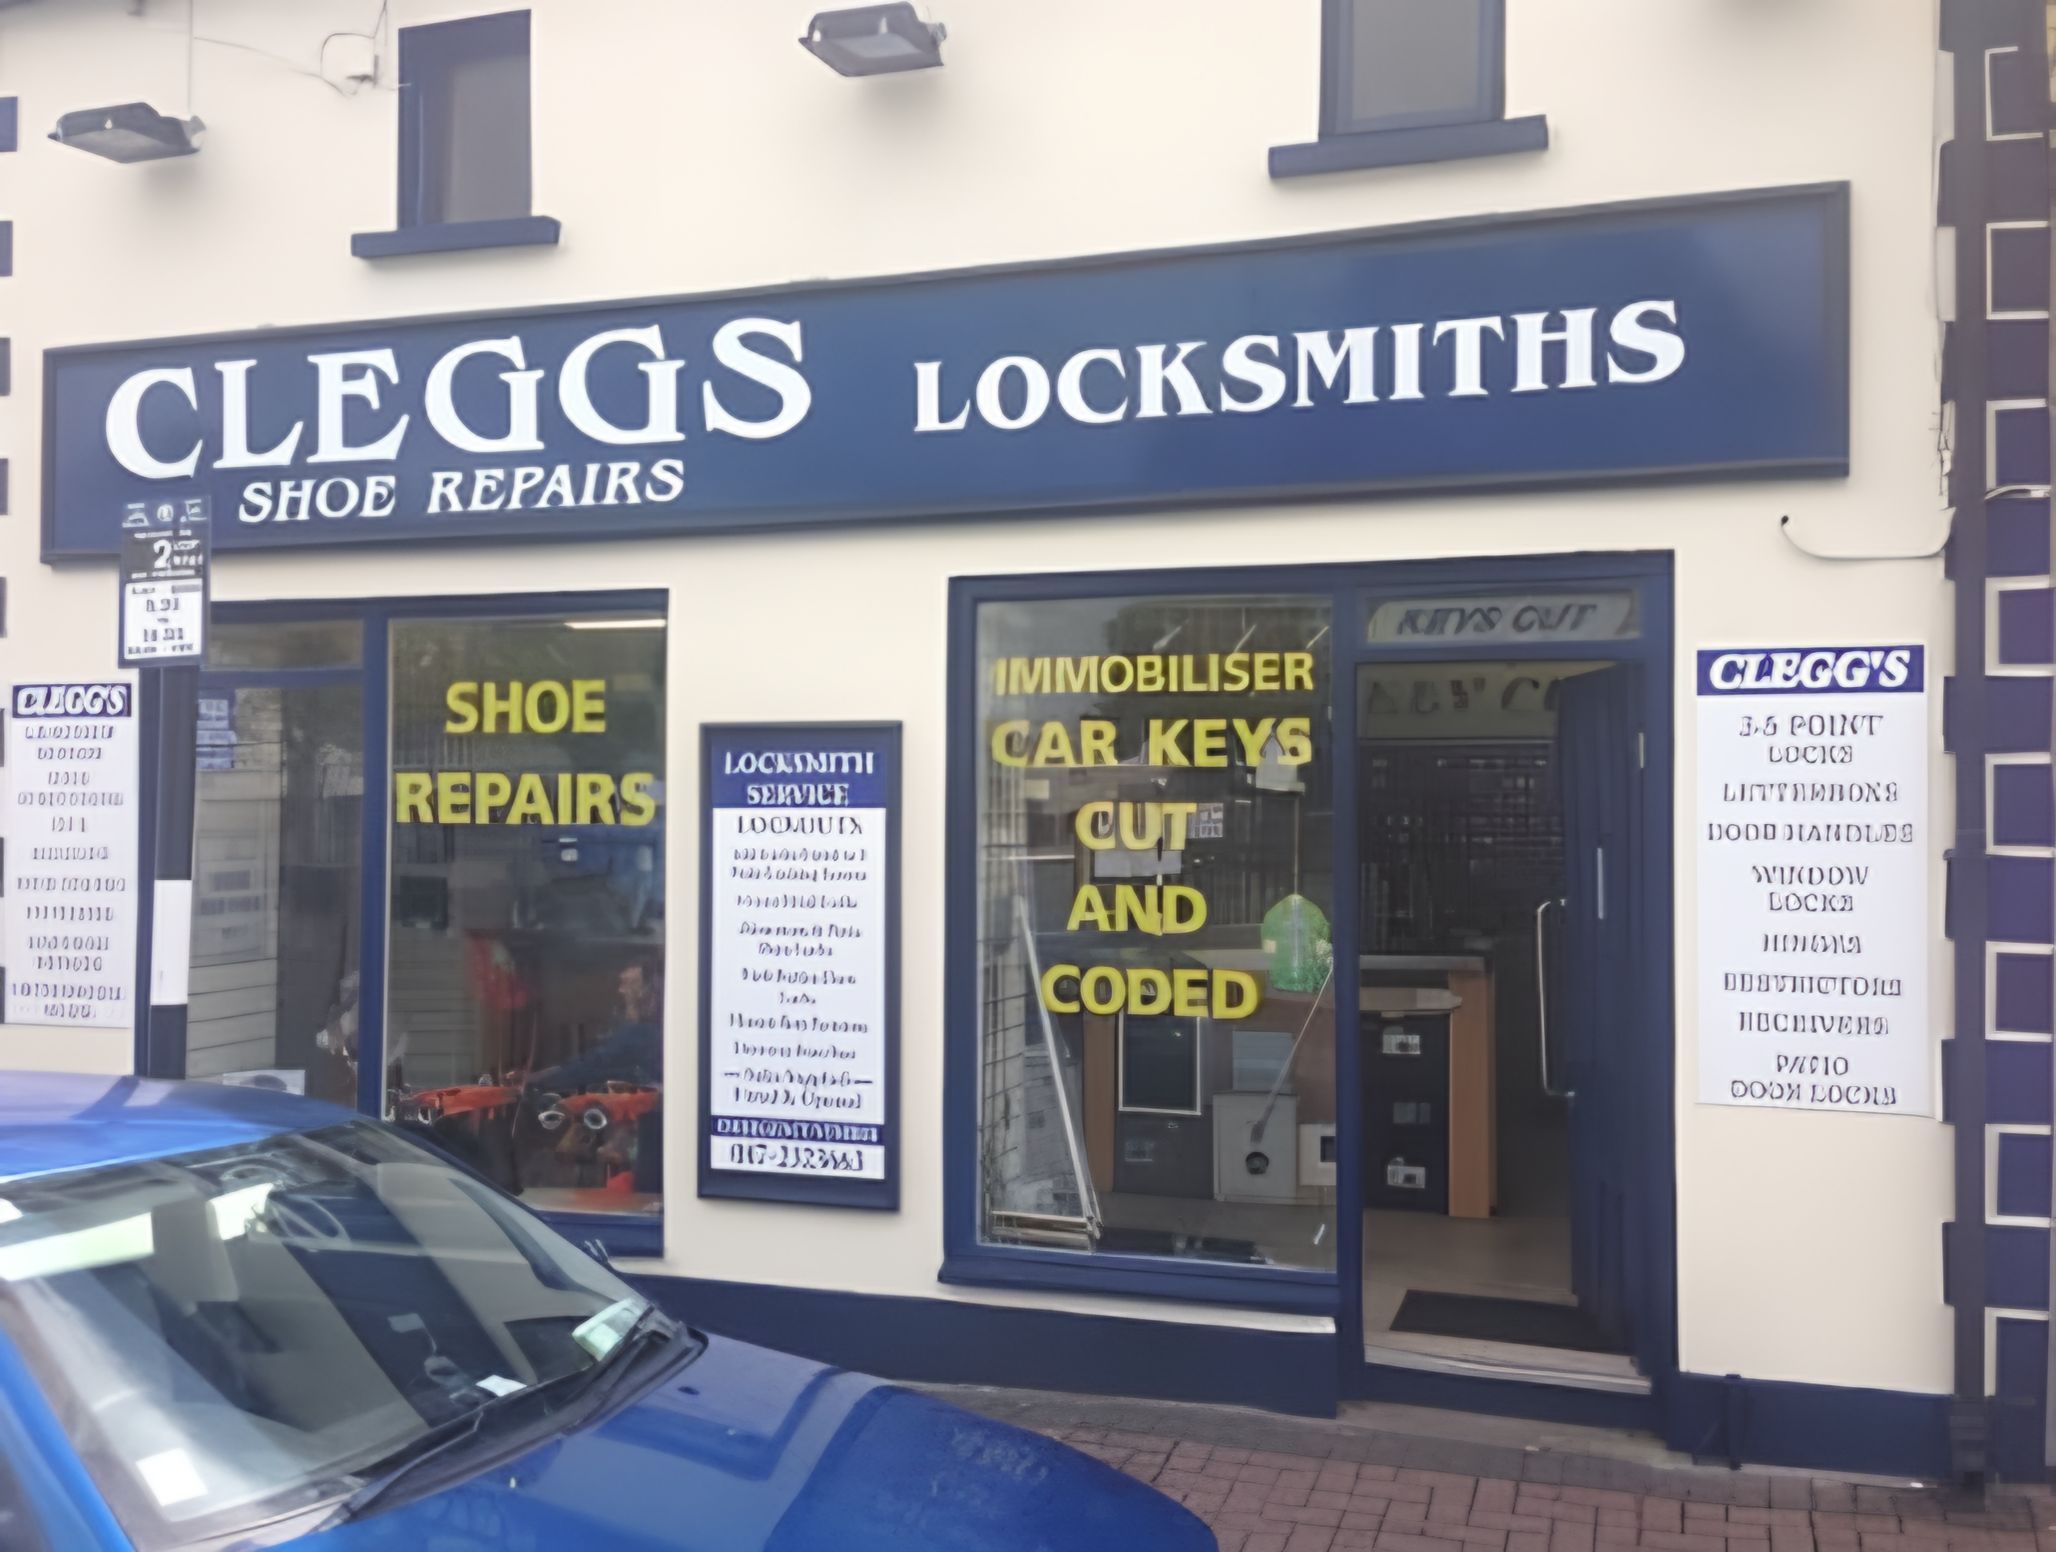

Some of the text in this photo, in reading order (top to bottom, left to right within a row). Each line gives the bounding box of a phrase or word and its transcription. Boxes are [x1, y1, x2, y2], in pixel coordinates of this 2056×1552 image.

[914, 300, 1686, 433] LOCKSMITHS
[105, 317, 812, 480] CLEGGS
[238, 475, 397, 524] SHOE
[427, 459, 685, 514] REPAIRS
[994, 652, 1315, 695] IMMOBILISER
[1709, 650, 1911, 690] CLEGG'S
[445, 679, 606, 734] SHOE
[1790, 713, 1884, 737] POINT
[991, 717, 1312, 768] CAR KEYS
[395, 771, 657, 827] REPAIRS
[1075, 801, 1197, 850] CUT
[1067, 884, 1208, 936] AND
[1041, 964, 1261, 1020] CODED
